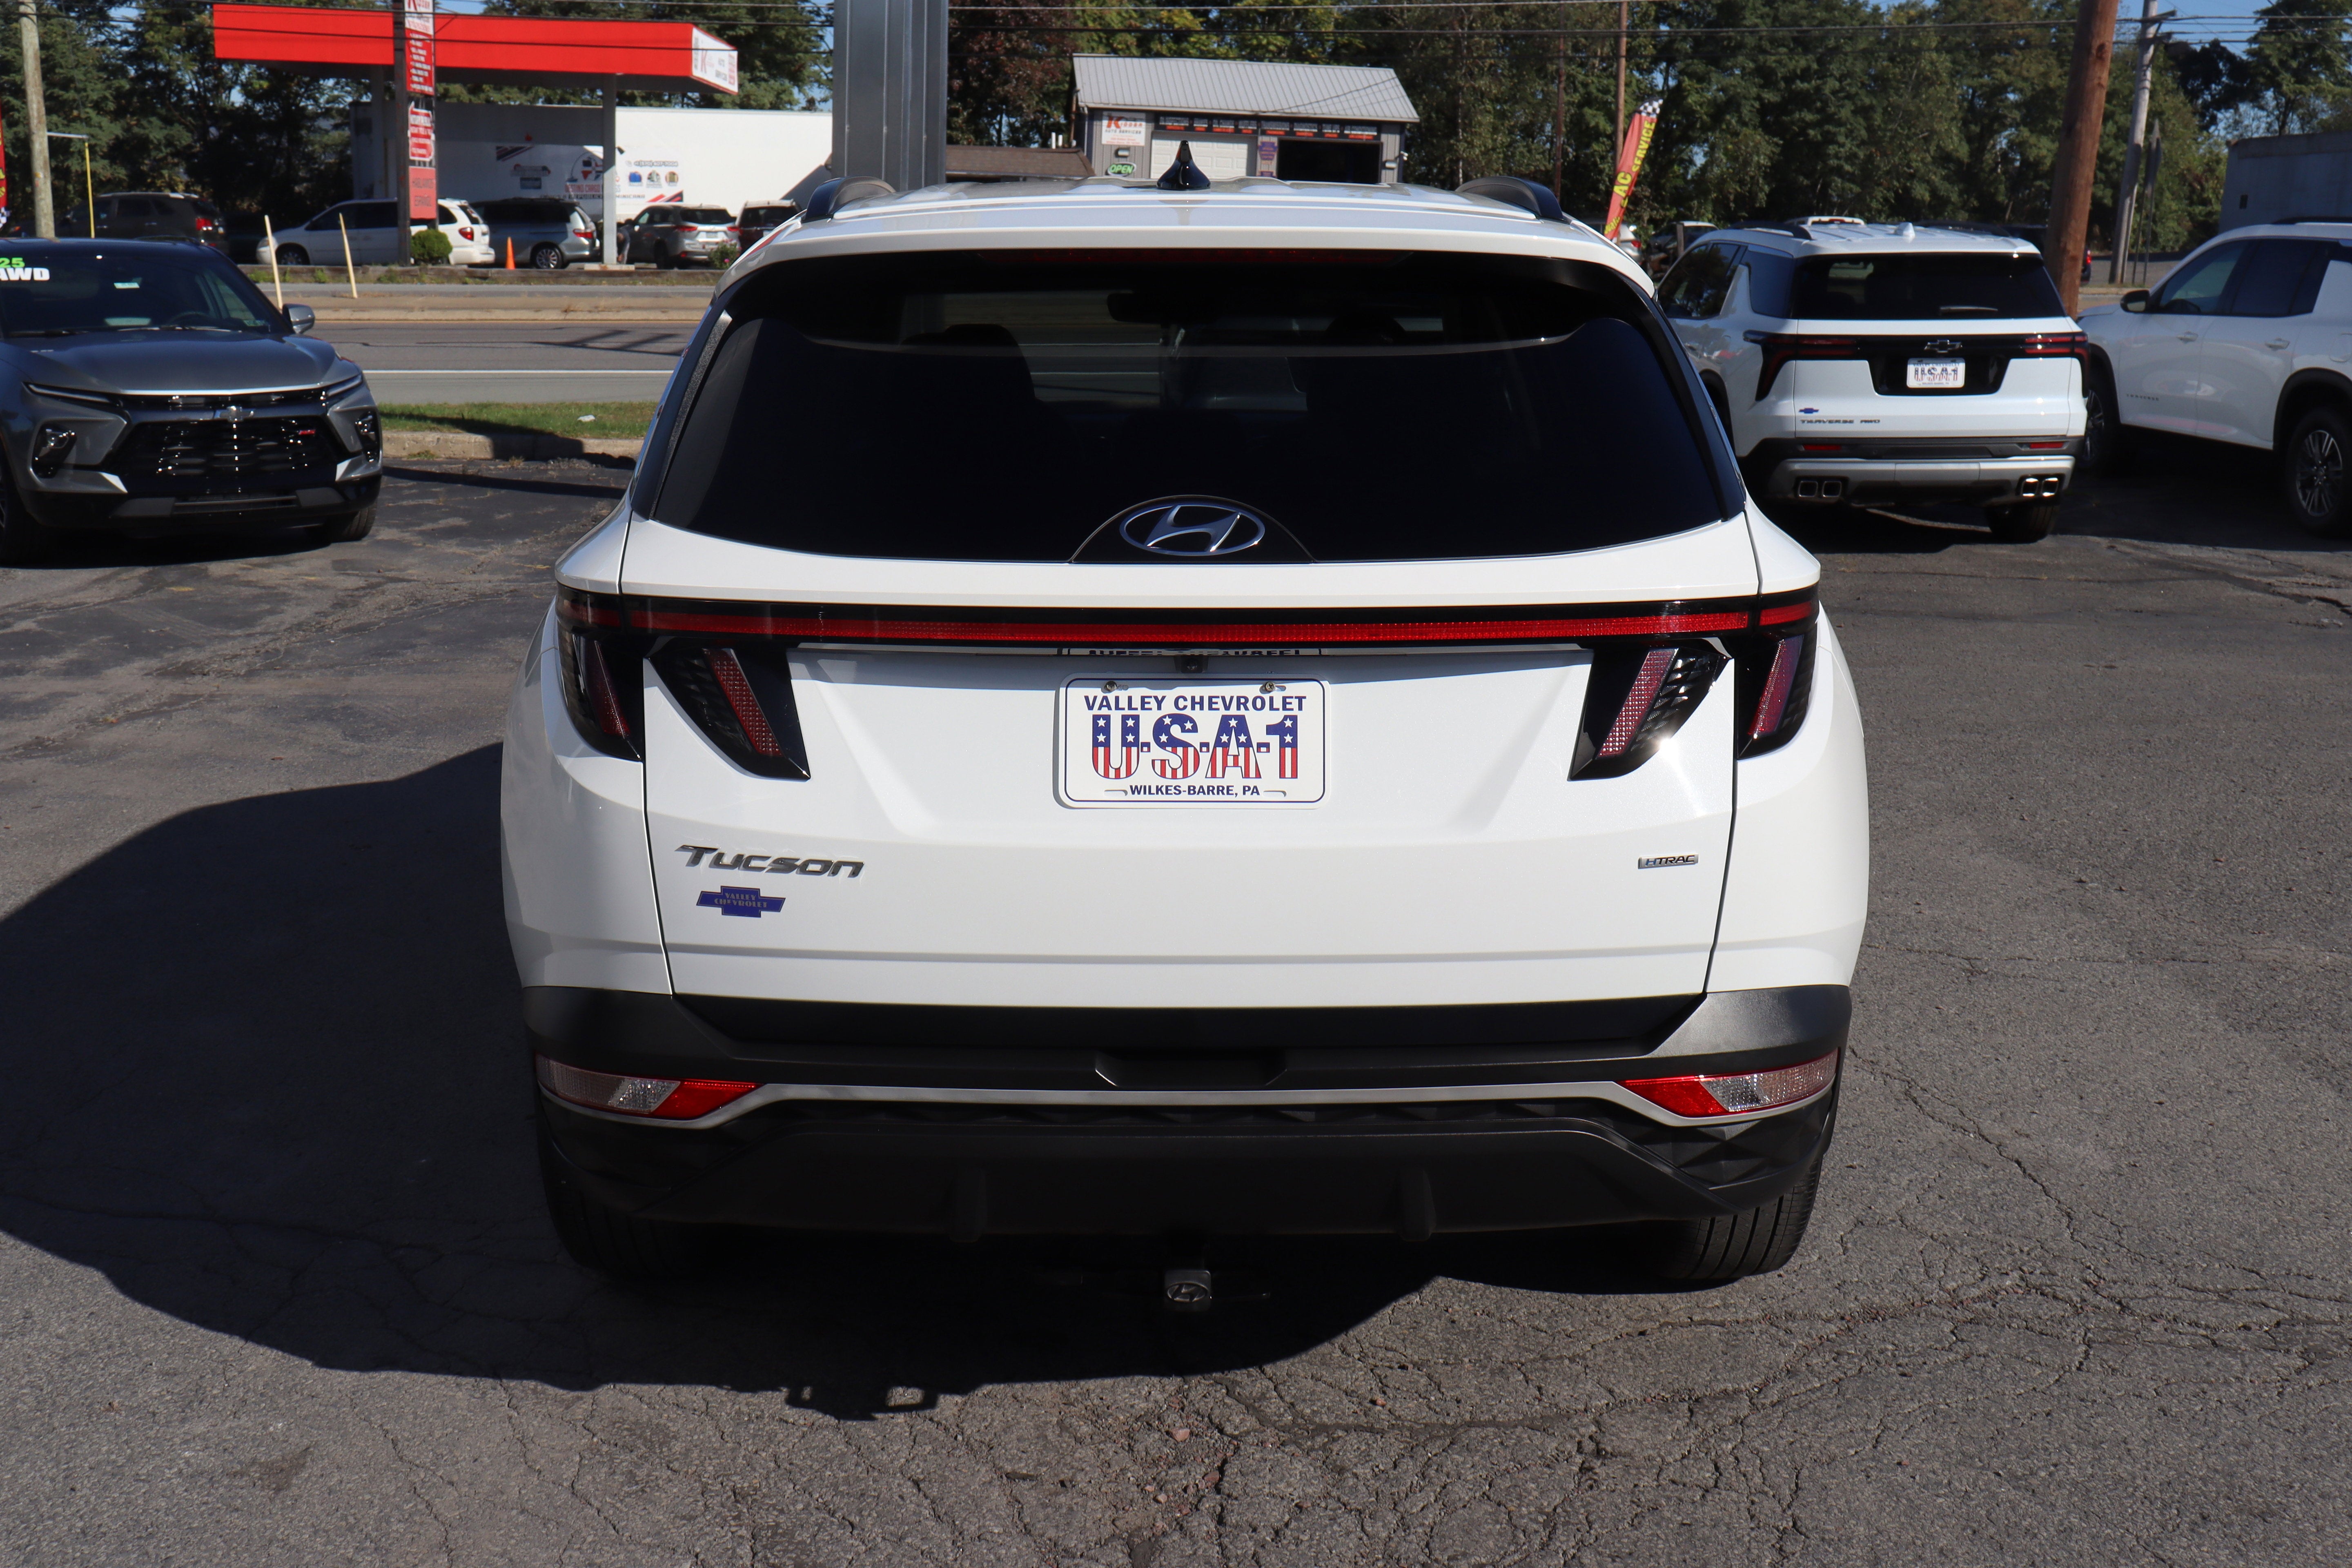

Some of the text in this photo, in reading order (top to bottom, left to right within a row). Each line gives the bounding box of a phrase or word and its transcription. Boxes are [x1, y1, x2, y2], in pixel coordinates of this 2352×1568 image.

[1613, 120, 1656, 197] AC SERVICE
[1110, 164, 1134, 174] OPEN
[1084, 695, 1306, 711] VALLEY CHEVROLET
[1130, 785, 1260, 797] WILKES-BARRE, PA
[1645, 855, 1695, 867] HTRAC
[714, 898, 768, 908] CHEVROLET
[725, 893, 756, 901] VALLEY
